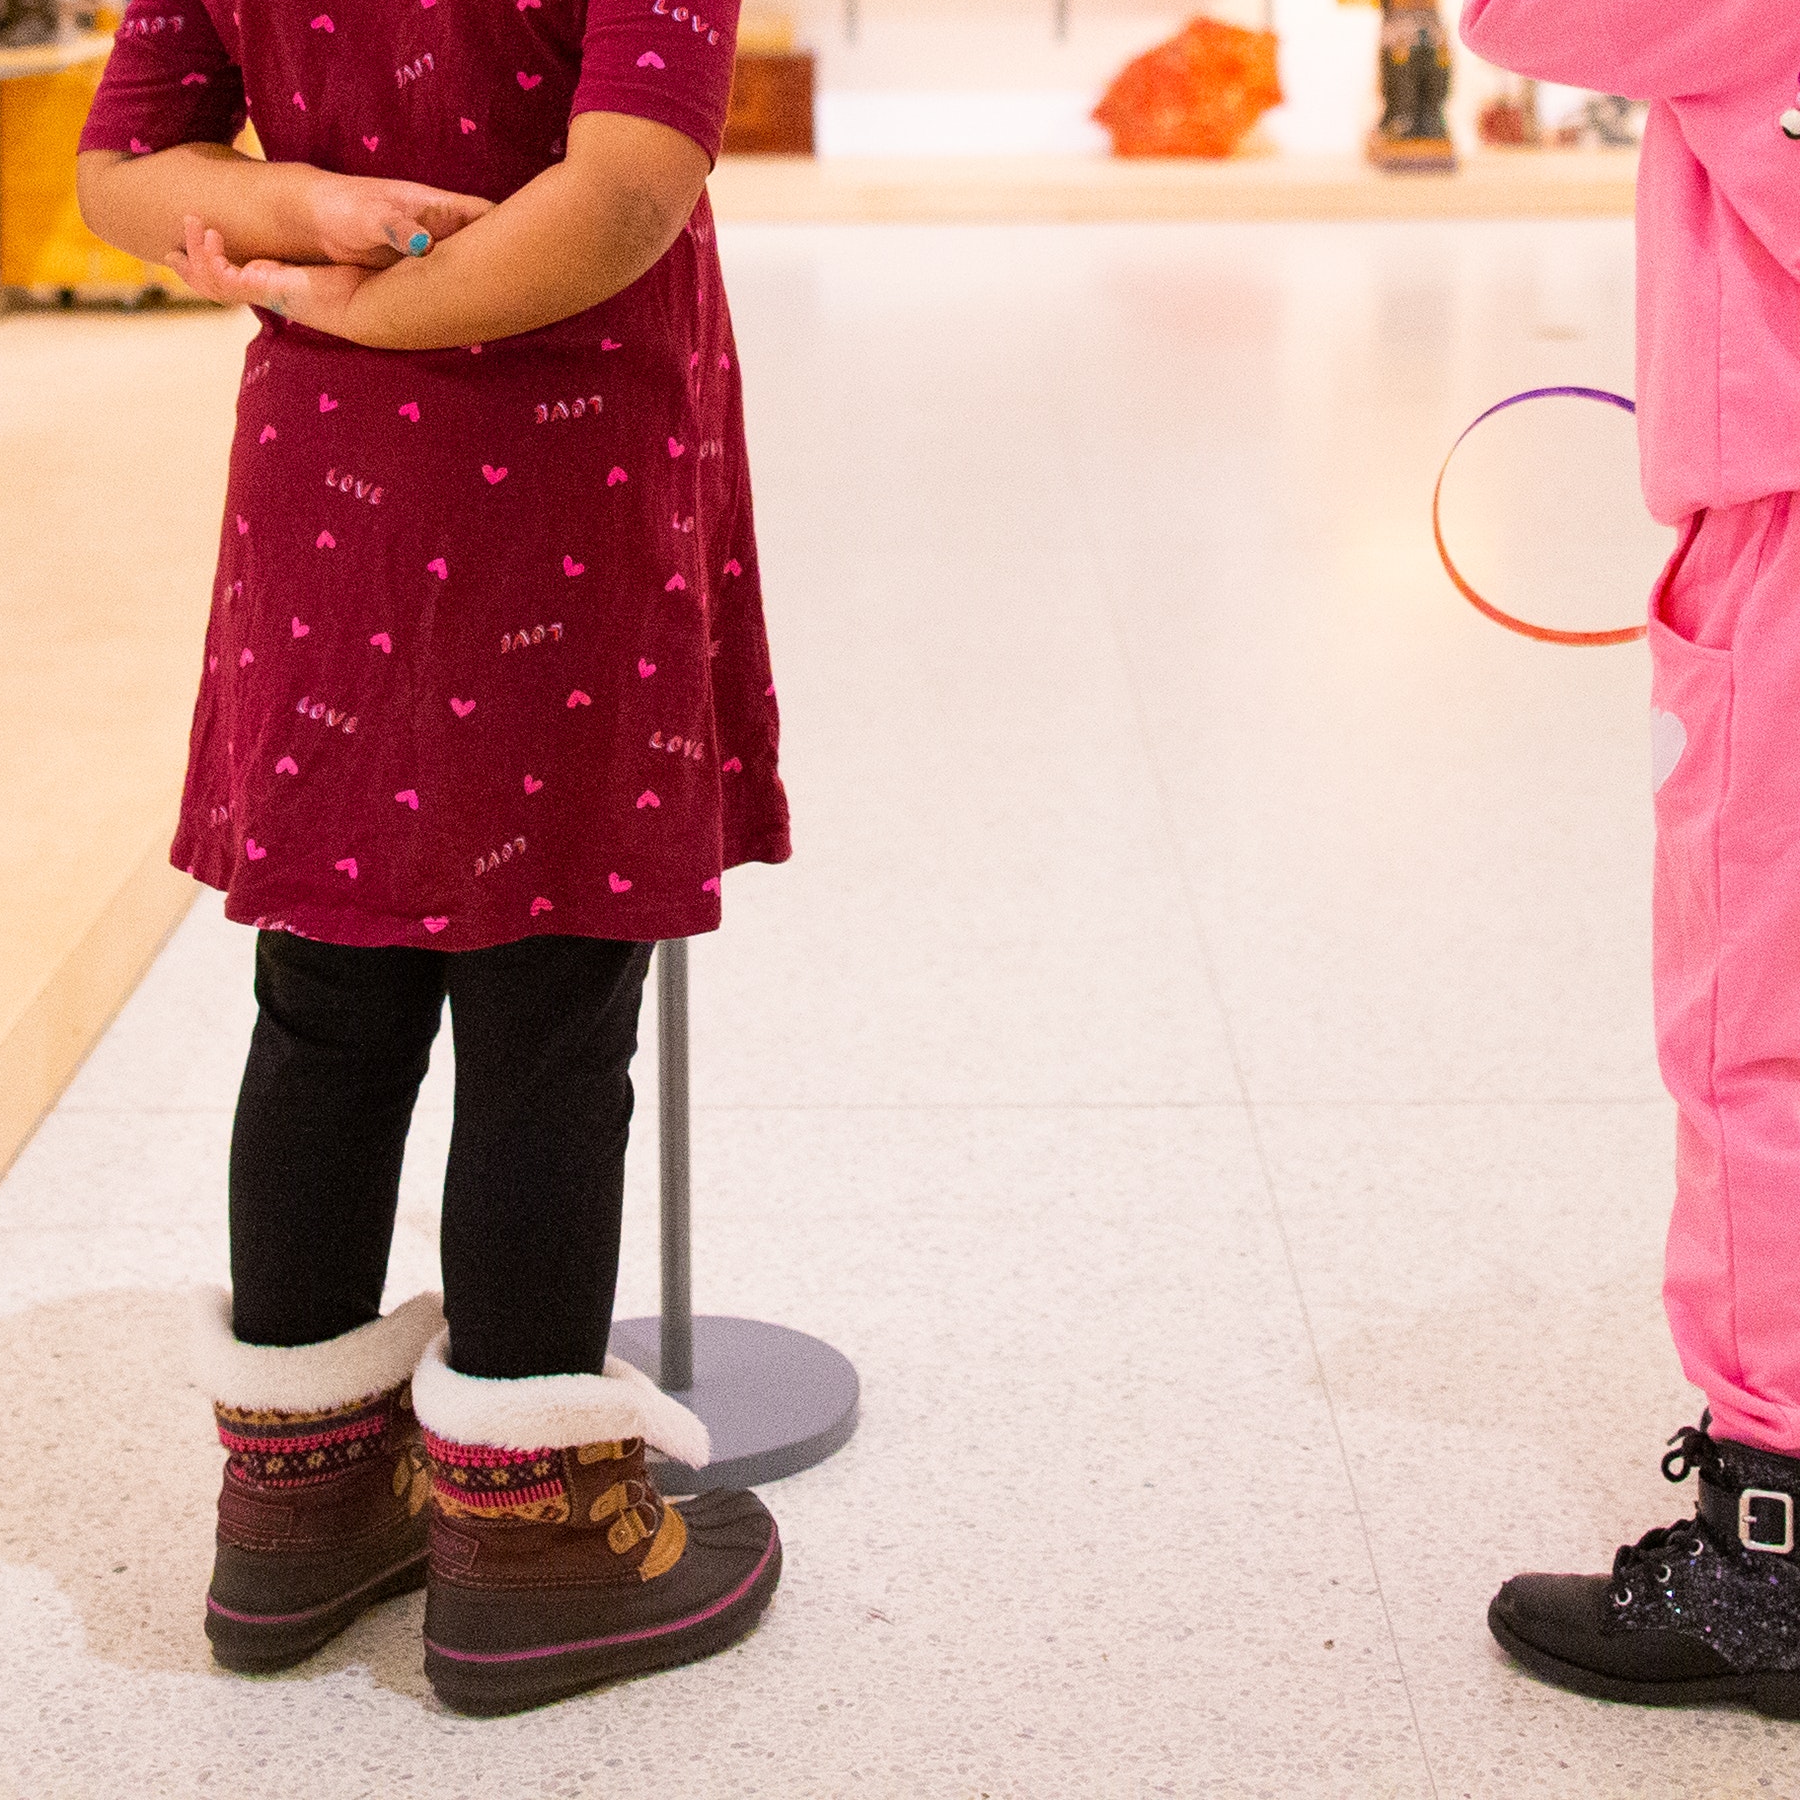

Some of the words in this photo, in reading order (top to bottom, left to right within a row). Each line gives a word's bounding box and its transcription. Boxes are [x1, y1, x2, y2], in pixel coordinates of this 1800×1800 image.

[535, 395, 603, 425] LOVE
[325, 467, 384, 505] LOVE
[500, 623, 563, 654] LOVE
[296, 696, 359, 735] LOVE
[649, 730, 705, 761] LOVE
[475, 835, 526, 877] LOVE
